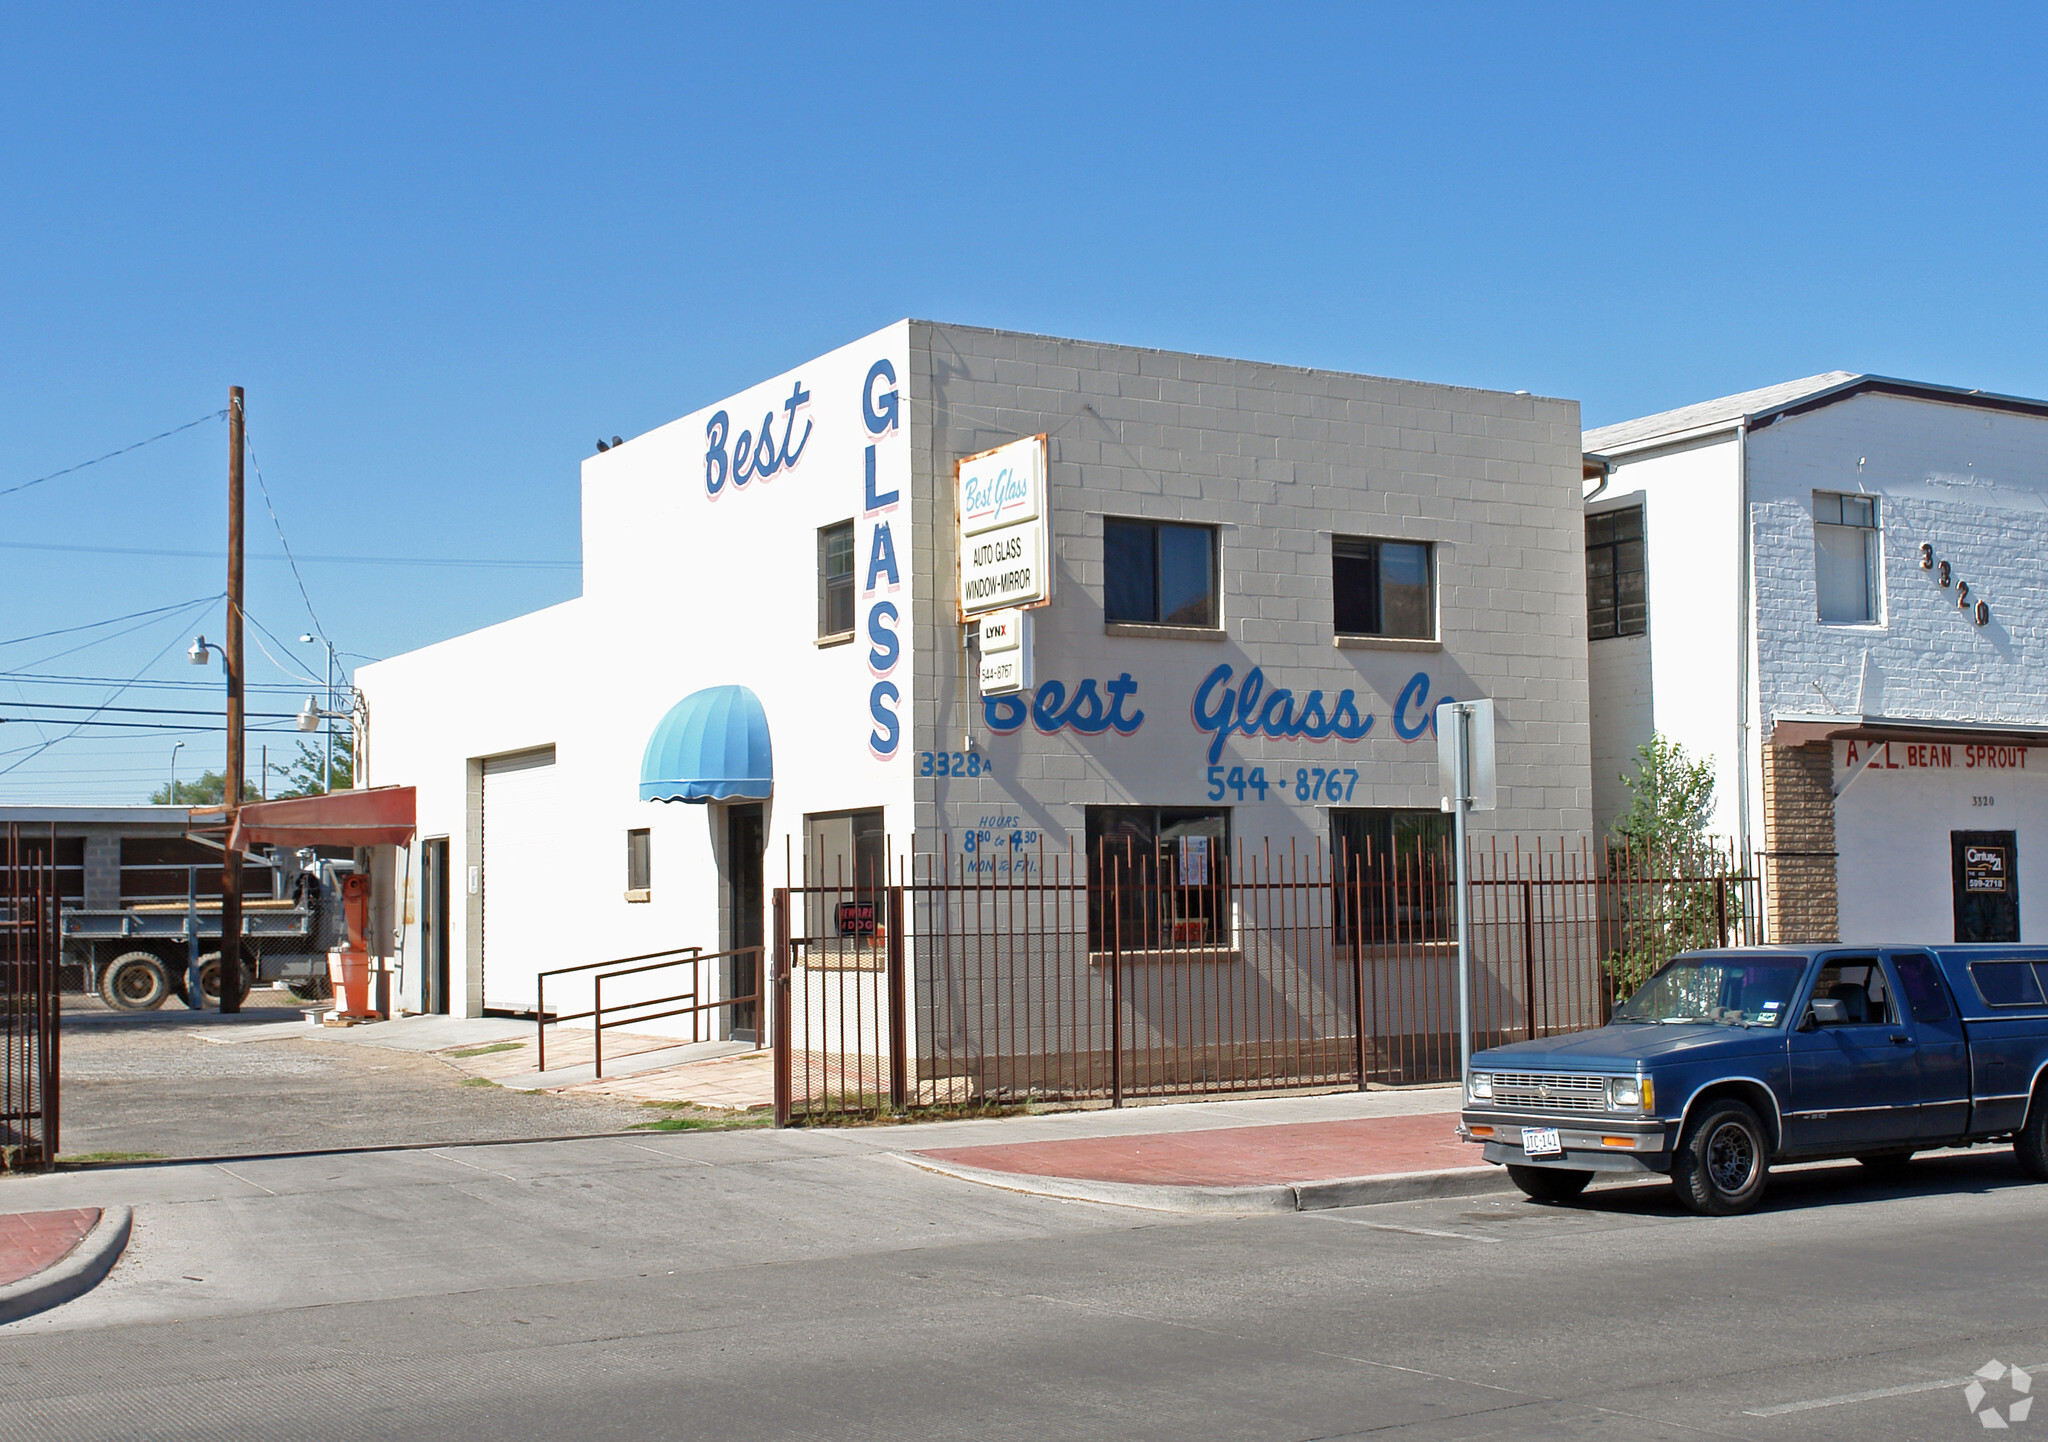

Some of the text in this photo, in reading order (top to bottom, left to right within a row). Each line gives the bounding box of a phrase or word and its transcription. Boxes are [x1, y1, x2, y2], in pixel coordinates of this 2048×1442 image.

[705, 381, 812, 500] Best
[965, 468, 1027, 520] Best Glass
[862, 358, 900, 762] GLASS
[973, 536, 1022, 568] AUTO GLASS
[1919, 543, 1989, 626] 3320
[986, 624, 1006, 639] LYNX
[981, 663, 1012, 682] 544-8767
[1191, 663, 1376, 765] Glass
[1907, 745, 1951, 767] BEAN
[1965, 745, 2028, 768] SPROUT
[1971, 796, 1994, 806] 3320
[979, 816, 1019, 827] HOURS
[994, 836, 1005, 847] to
[967, 860, 993, 873] MON
[1967, 848, 2002, 871] Century 21
